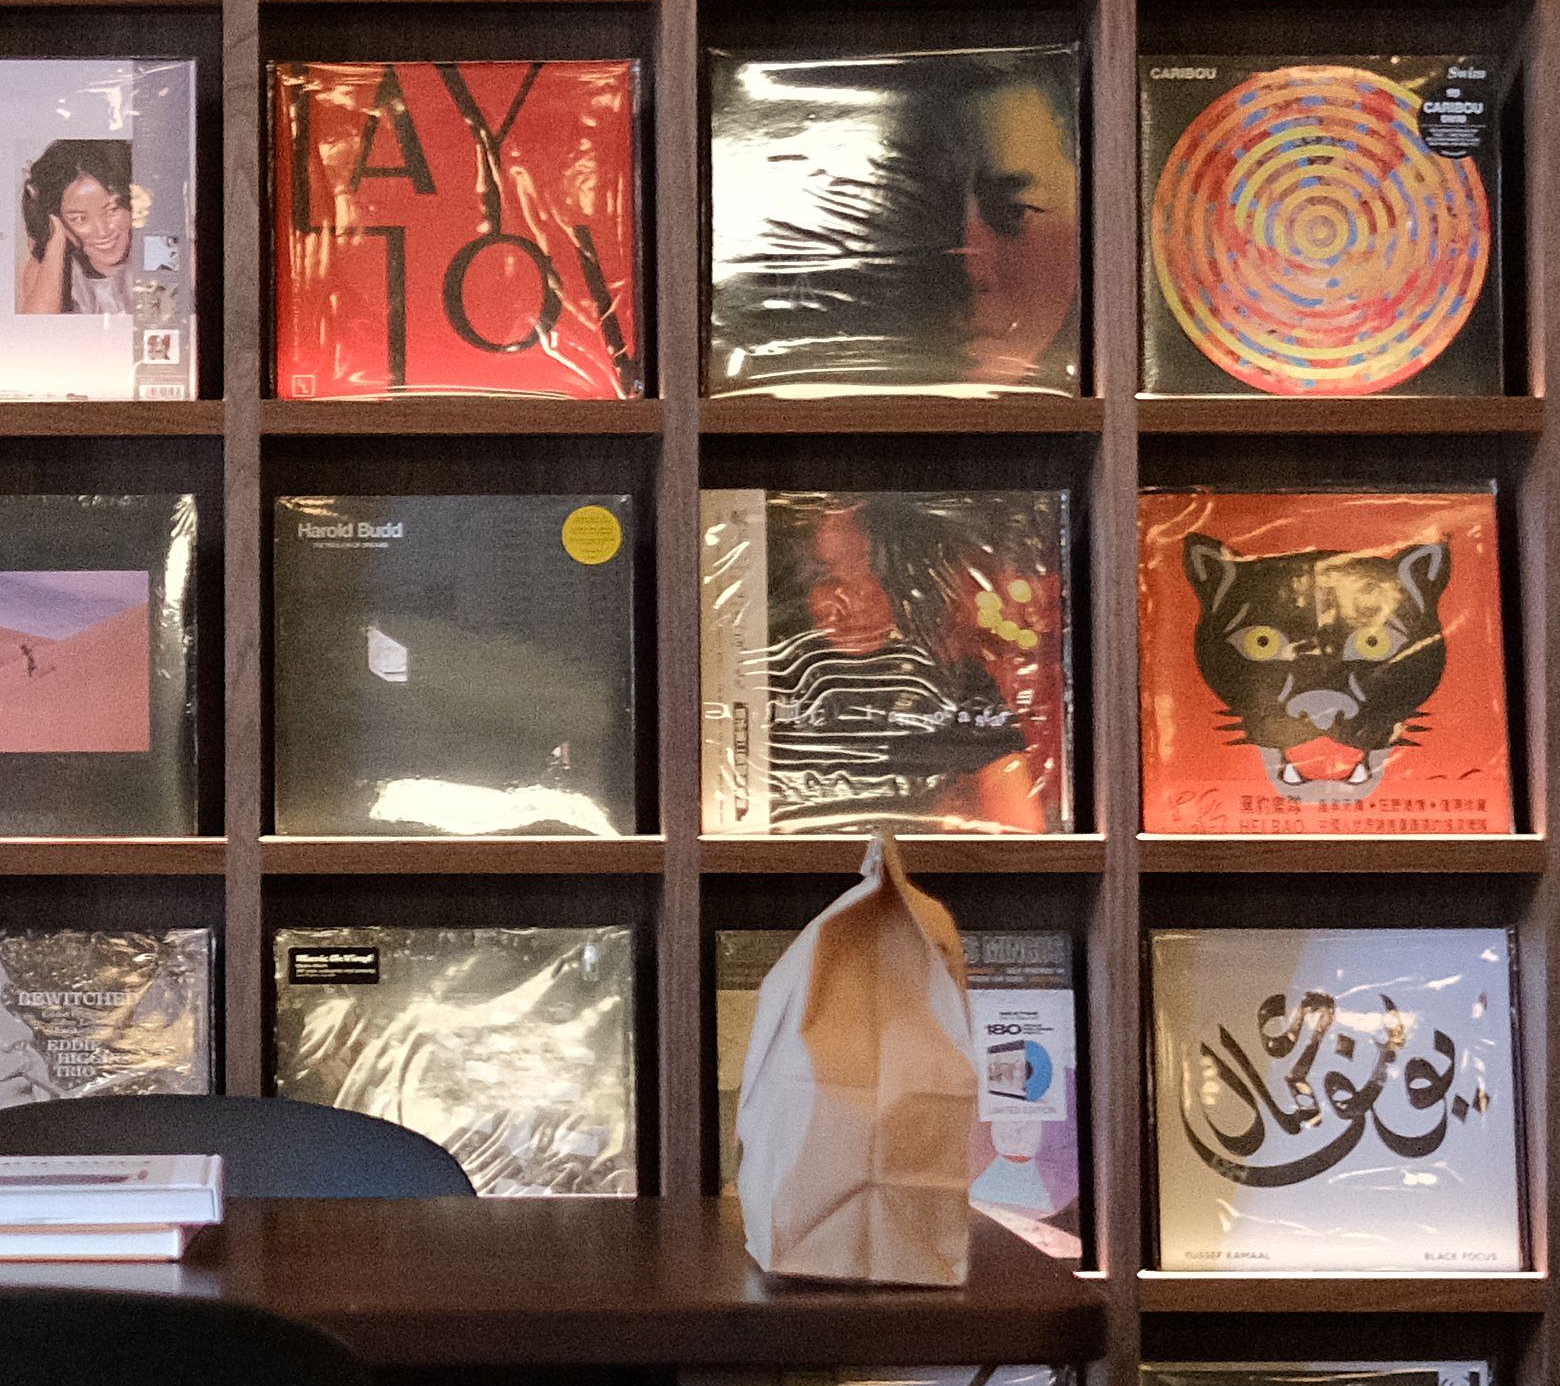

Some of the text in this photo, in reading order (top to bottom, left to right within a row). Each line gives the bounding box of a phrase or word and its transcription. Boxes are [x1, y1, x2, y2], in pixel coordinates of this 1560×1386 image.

[1150, 67, 1218, 80] CARIBOU
[1422, 101, 1484, 114] CARIBOU
[297, 520, 404, 540] Harold Budd
[17, 991, 140, 1007] BEWITCHED
[984, 1023, 1023, 1037] 180
[54, 1065, 97, 1078] TRIO
[1424, 1251, 1459, 1262] BLACK
